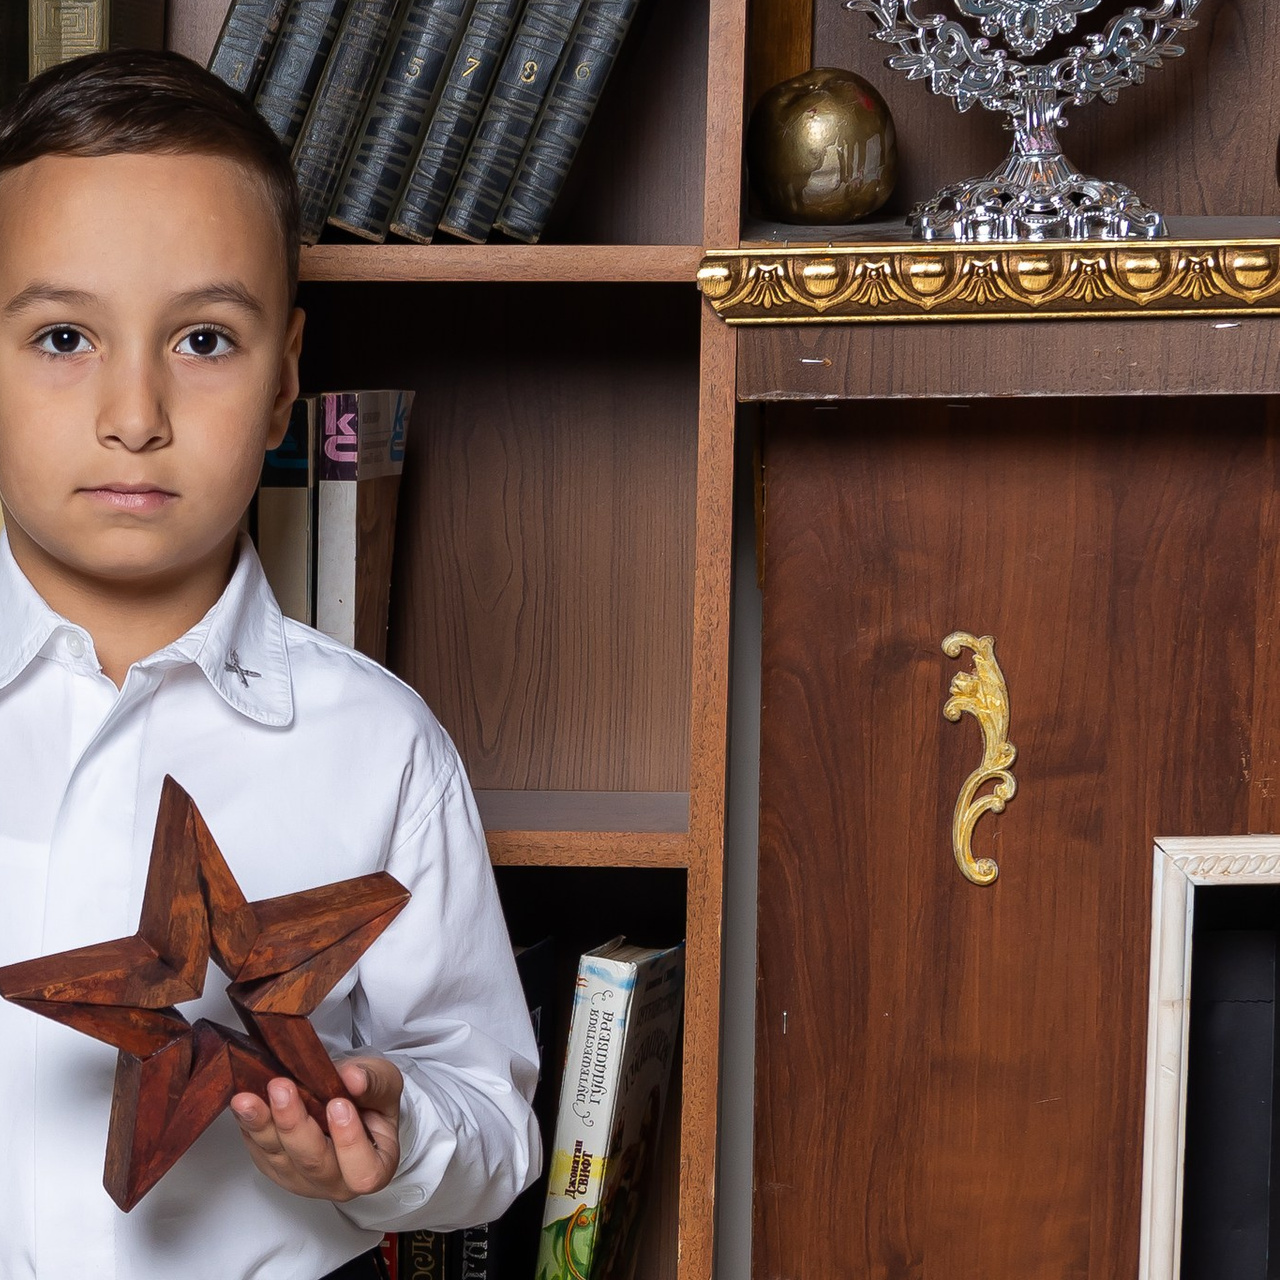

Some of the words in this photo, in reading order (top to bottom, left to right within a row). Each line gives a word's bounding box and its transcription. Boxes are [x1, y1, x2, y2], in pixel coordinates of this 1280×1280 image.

[405, 58, 425, 78] 5
[463, 57, 481, 77] 7
[575, 60, 592, 81] 6
[564, 1140, 583, 1201] Джонатан
[577, 1150, 595, 1196] СВИФТ
